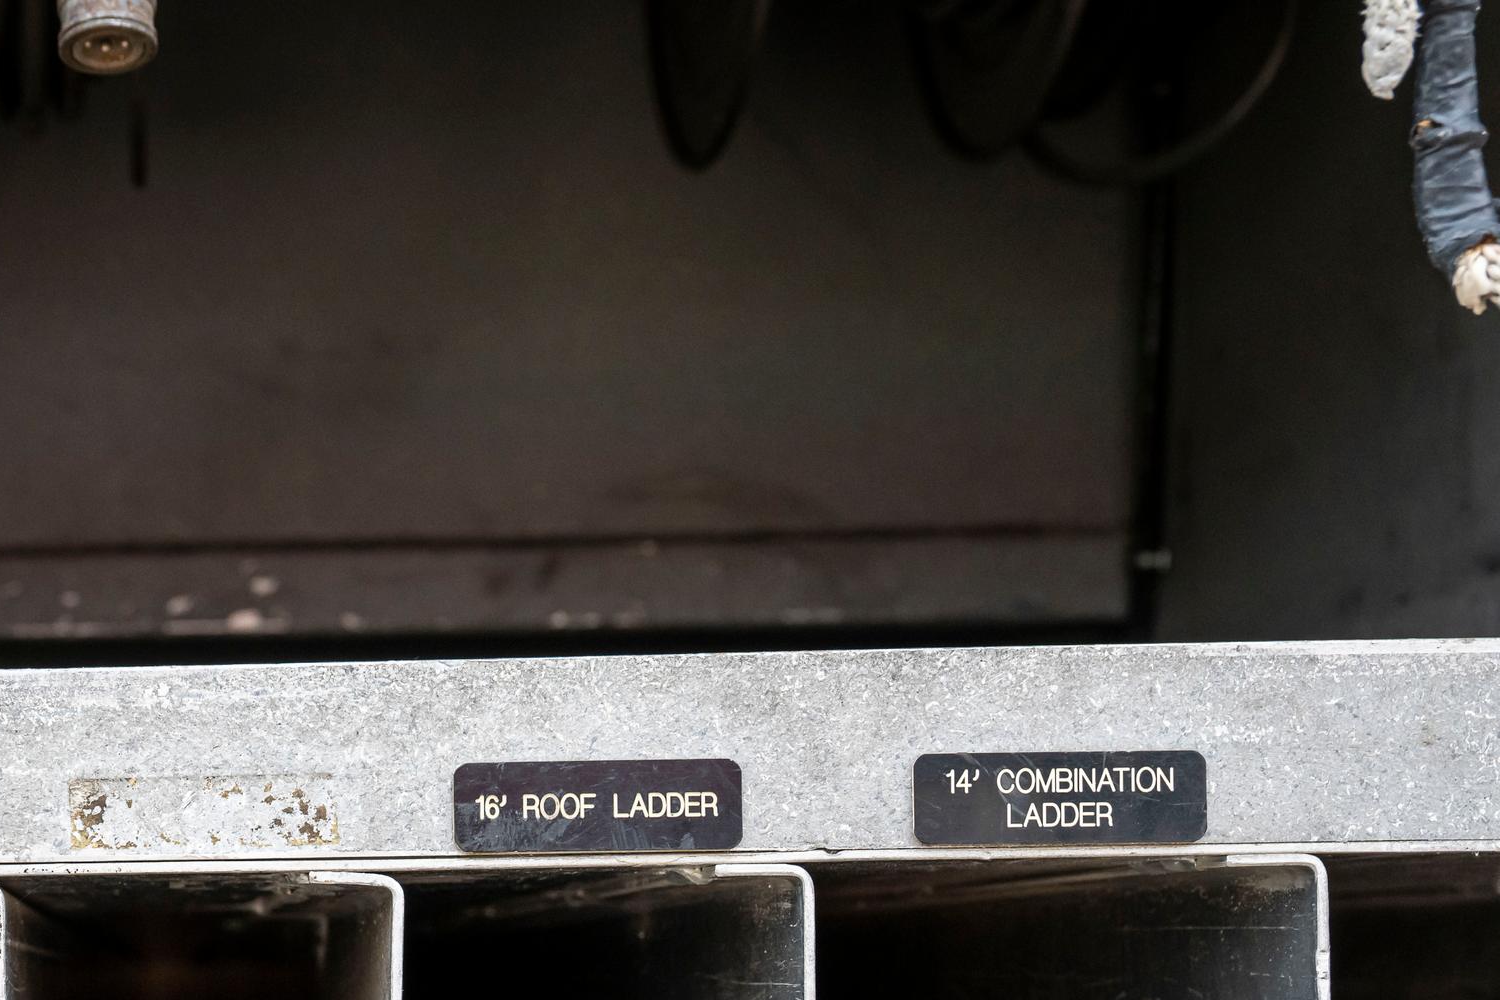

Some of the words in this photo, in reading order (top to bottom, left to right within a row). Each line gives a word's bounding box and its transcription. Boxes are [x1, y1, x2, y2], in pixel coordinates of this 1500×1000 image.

[946, 769, 980, 794] 14'
[996, 767, 1175, 794] COMBINATION
[475, 794, 508, 820] 16'
[522, 793, 597, 820] ROOF
[613, 791, 719, 818] LADDER
[1007, 802, 1113, 828] LADDER
